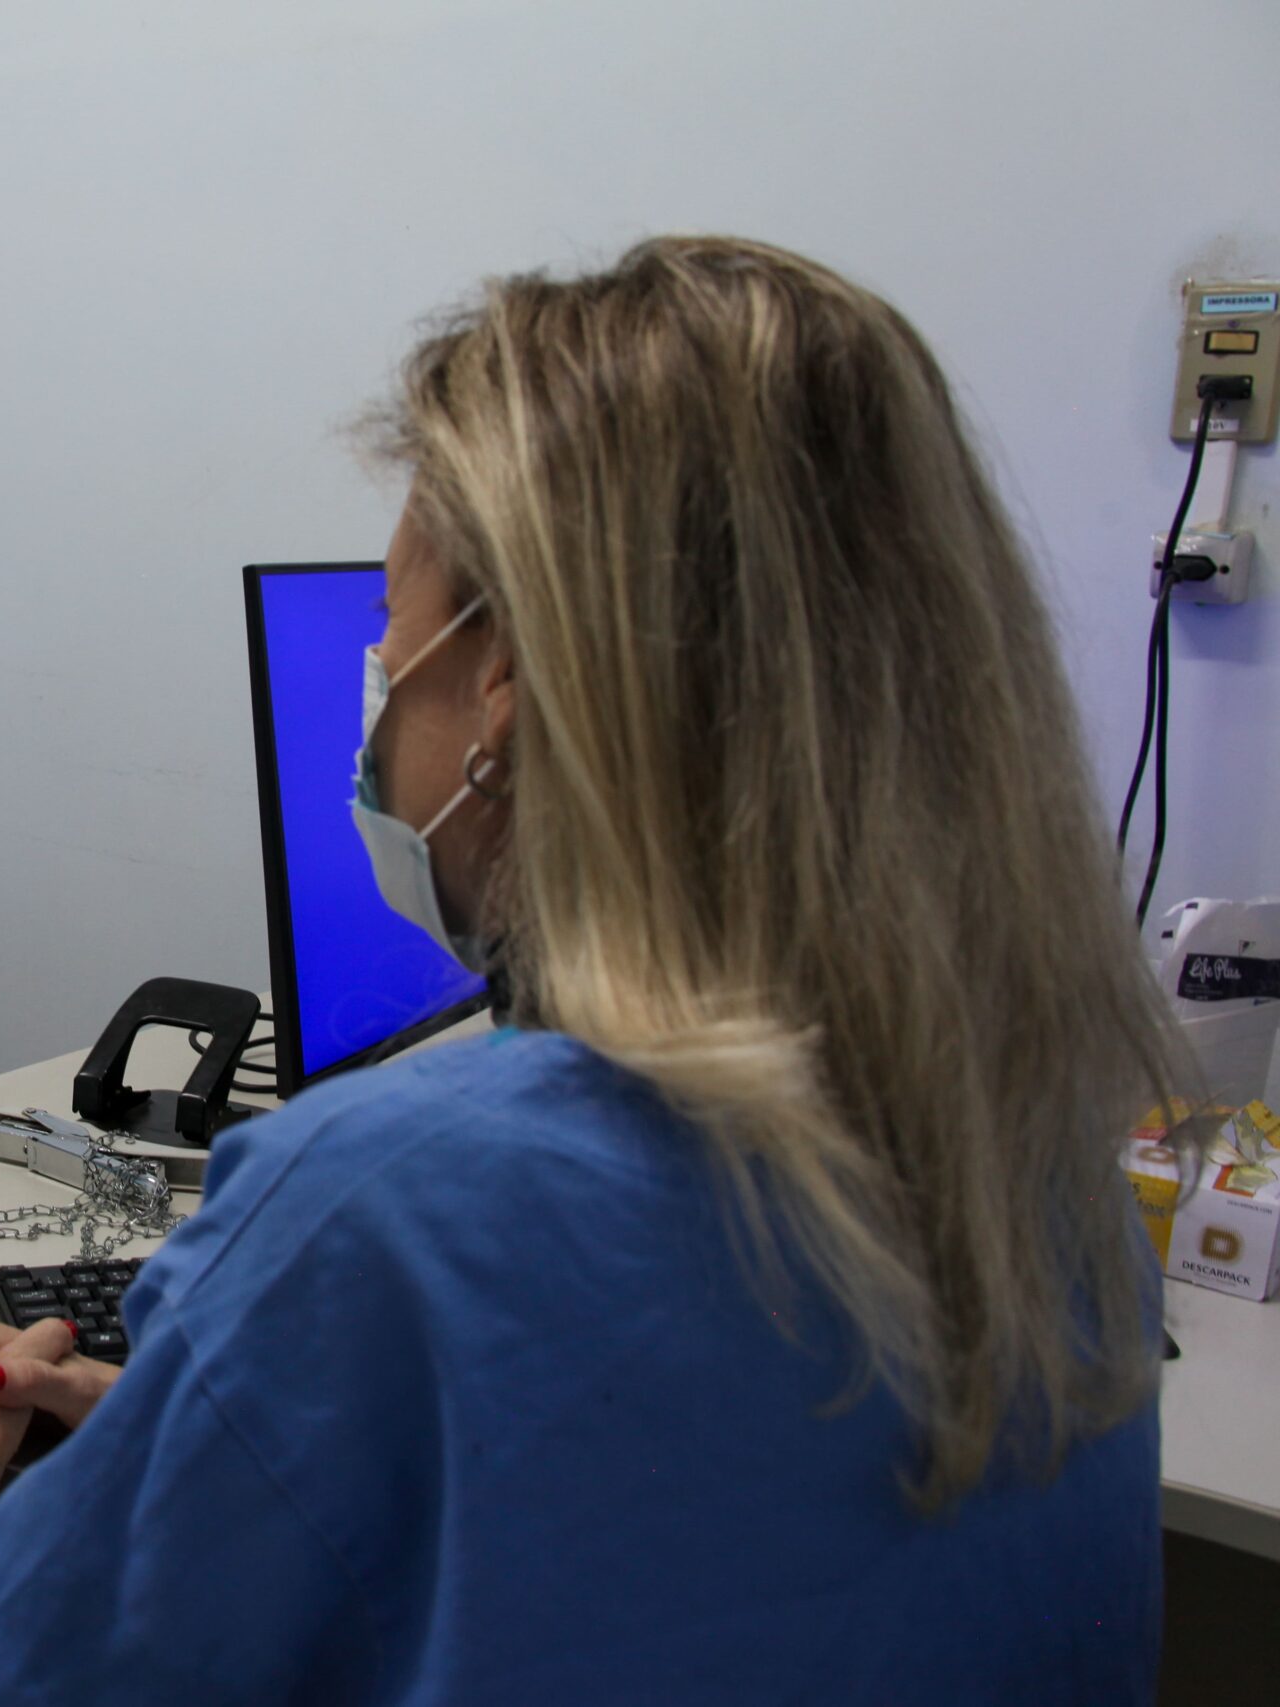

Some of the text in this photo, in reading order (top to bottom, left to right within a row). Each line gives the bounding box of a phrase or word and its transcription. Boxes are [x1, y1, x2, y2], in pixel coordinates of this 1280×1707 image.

[1207, 295, 1271, 306] IMPRESSORA
[1189, 956, 1242, 984] Life Plus
[1181, 1259, 1251, 1287] DESCARPACK
